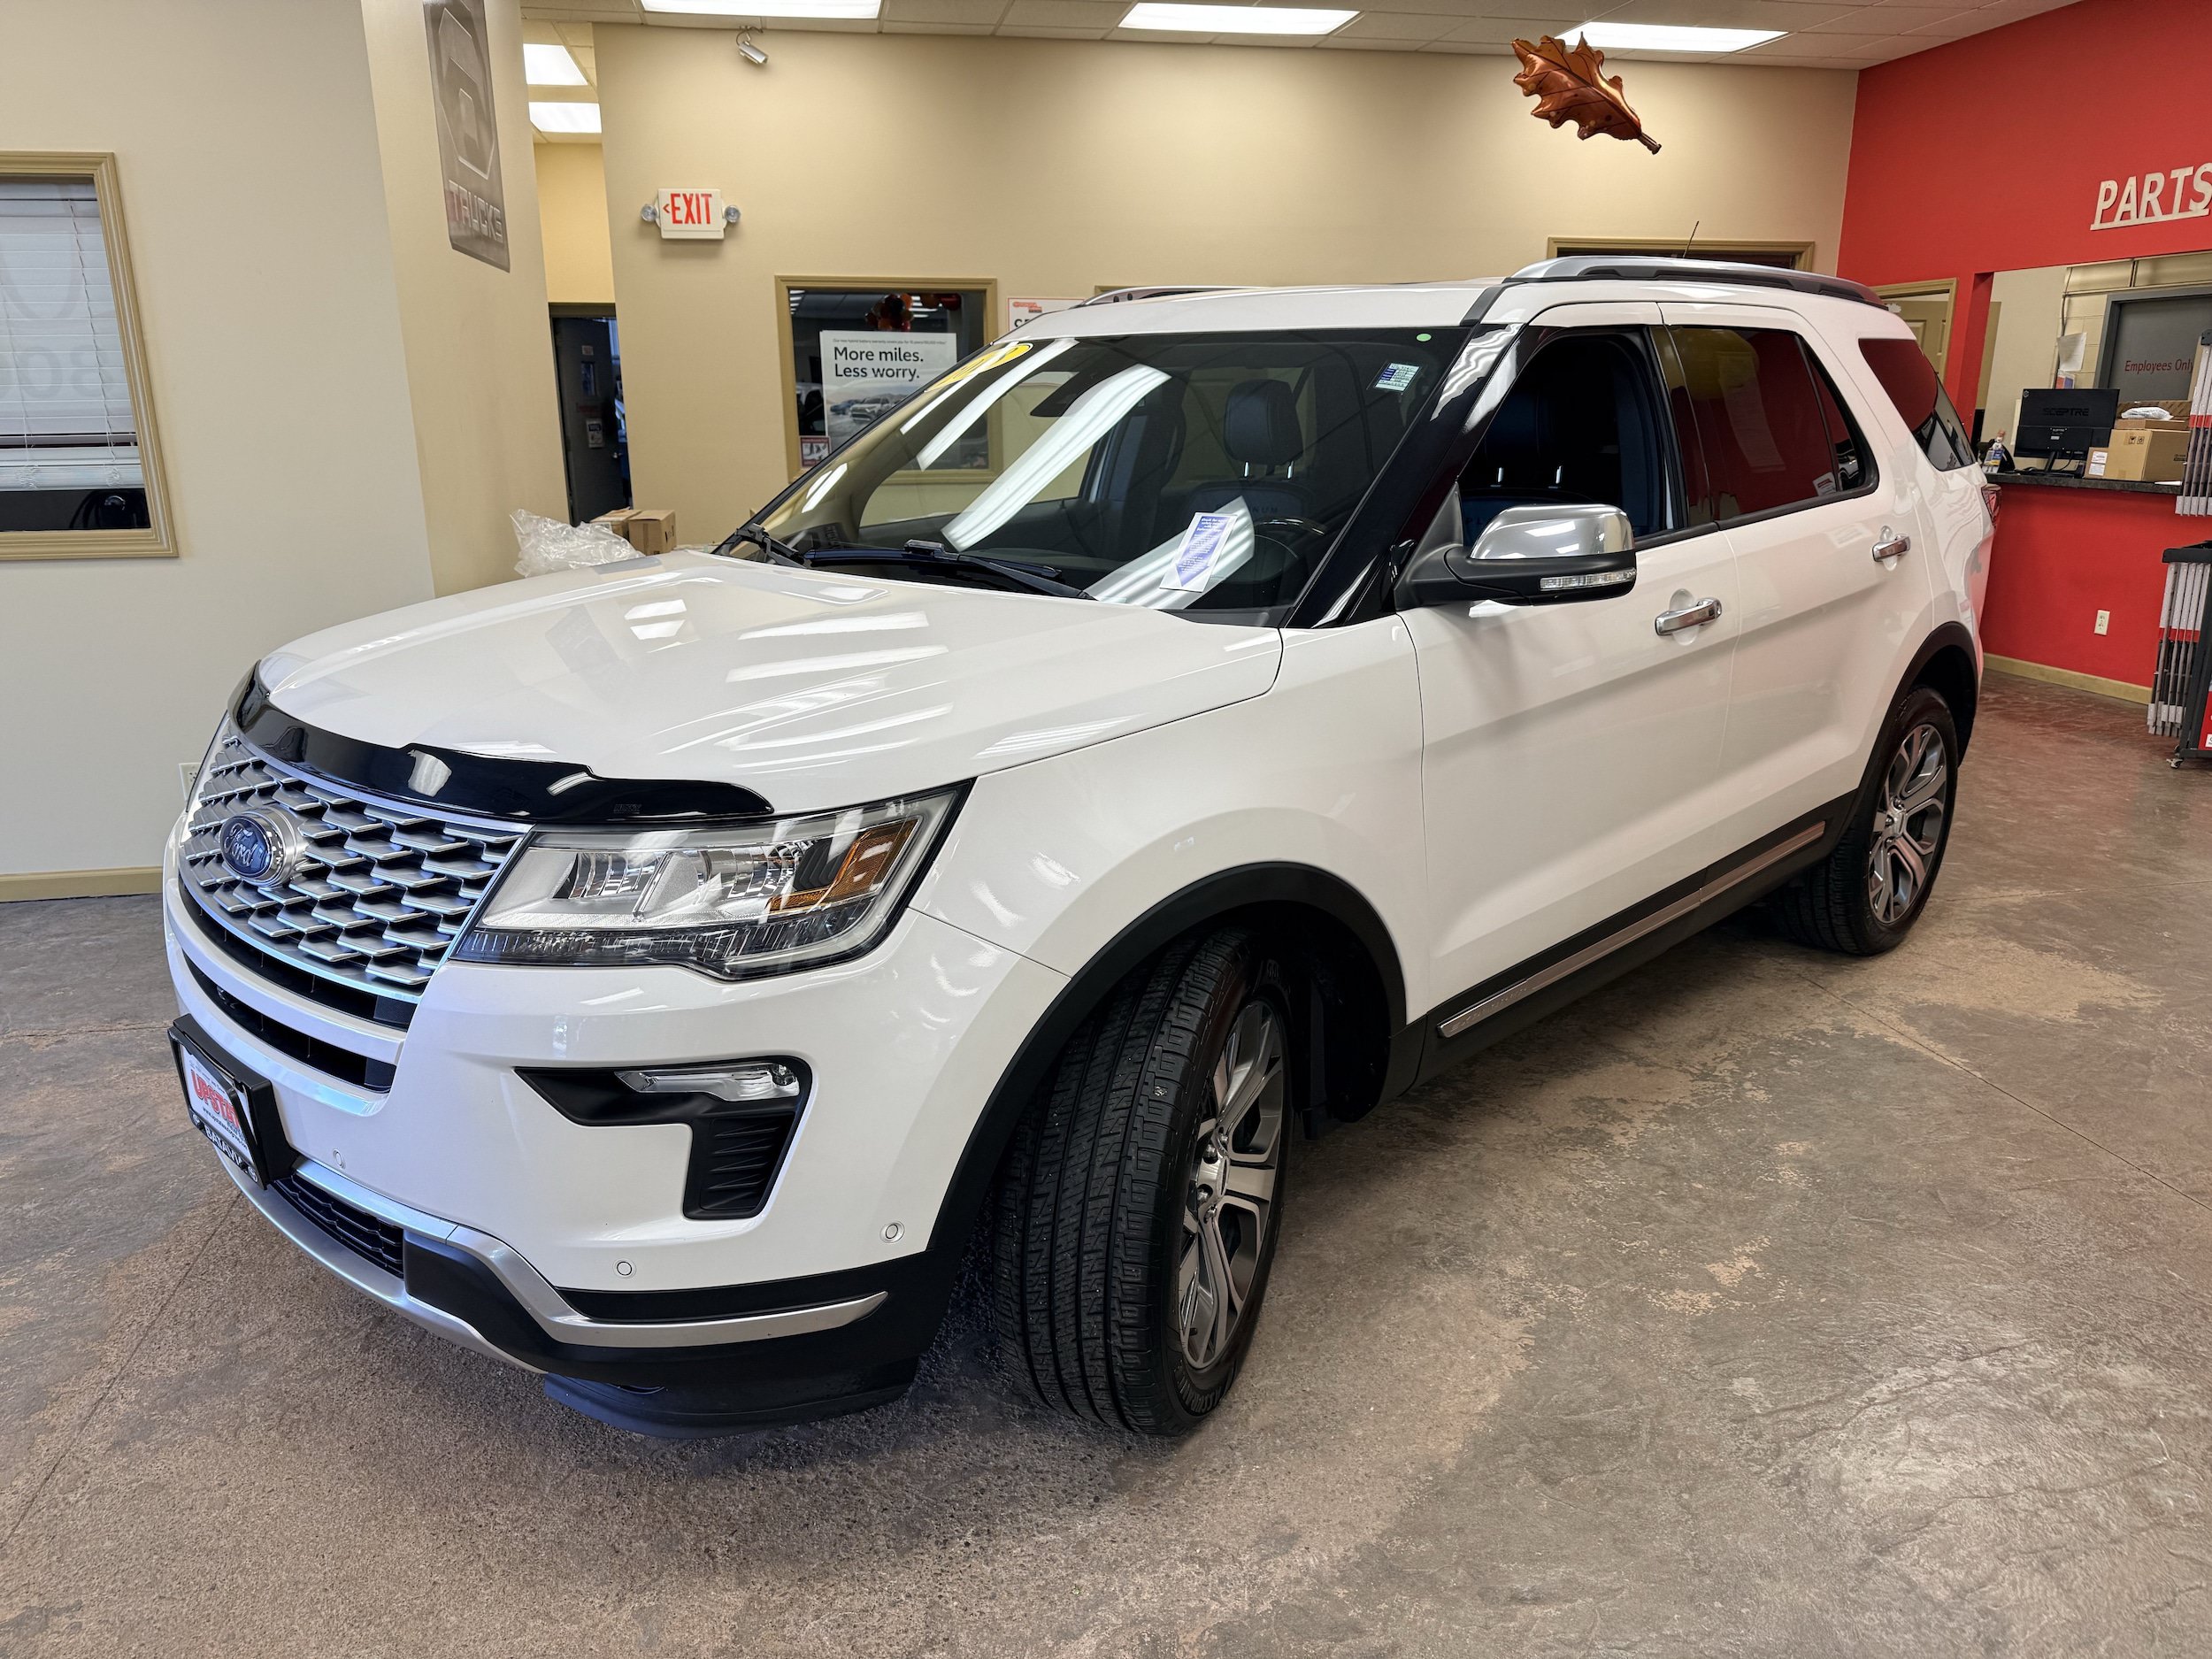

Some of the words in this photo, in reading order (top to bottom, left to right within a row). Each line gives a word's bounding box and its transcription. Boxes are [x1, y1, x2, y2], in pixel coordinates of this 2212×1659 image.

[670, 192, 712, 225] EXIT
[2093, 162, 2212, 227] PARTS
[448, 180, 503, 244] TRUCKS
[833, 346, 874, 361] More
[879, 348, 924, 362] miles.
[2124, 360, 2172, 374] Employees
[834, 364, 867, 378] Less
[872, 367, 920, 381] worry.
[2043, 408, 2089, 417] SCEPTRE
[224, 822, 258, 867] Ford
[191, 1069, 240, 1129] UPSTAT
